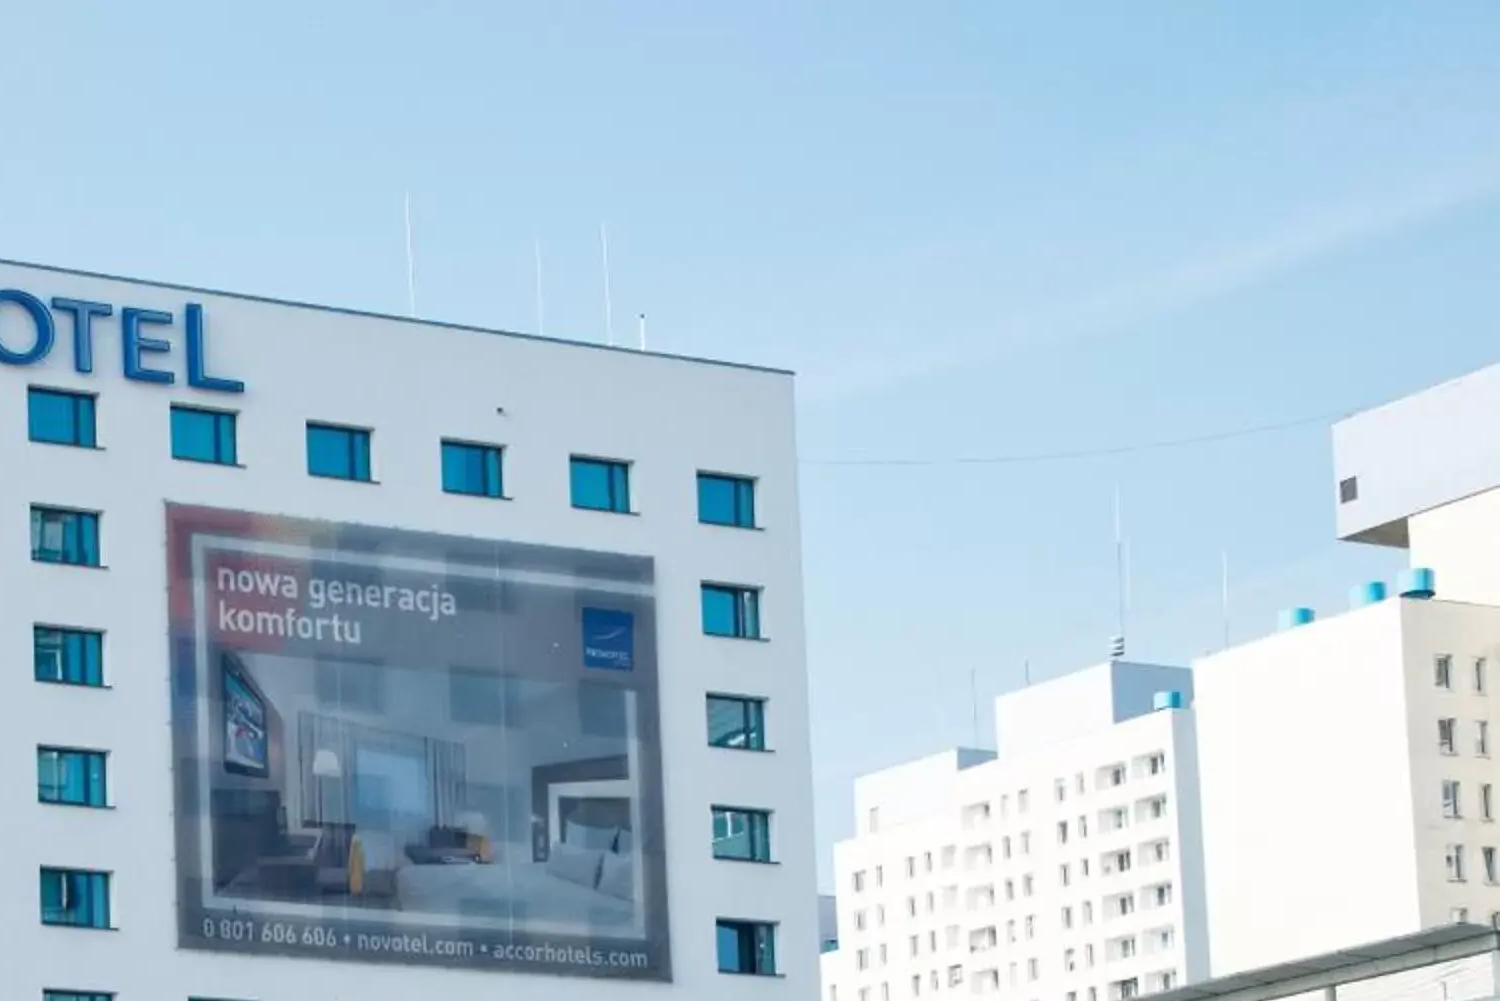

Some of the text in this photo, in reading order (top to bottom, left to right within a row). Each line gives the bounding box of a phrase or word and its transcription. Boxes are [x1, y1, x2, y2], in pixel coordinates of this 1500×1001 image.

[217, 566, 457, 622] nowa generacja
[219, 600, 362, 644] komfortu
[219, 918, 253, 940] 801
[261, 922, 298, 944] 606
[302, 926, 337, 947] 606
[357, 933, 474, 958] novotel.com
[493, 941, 649, 969] accorhotels.com
